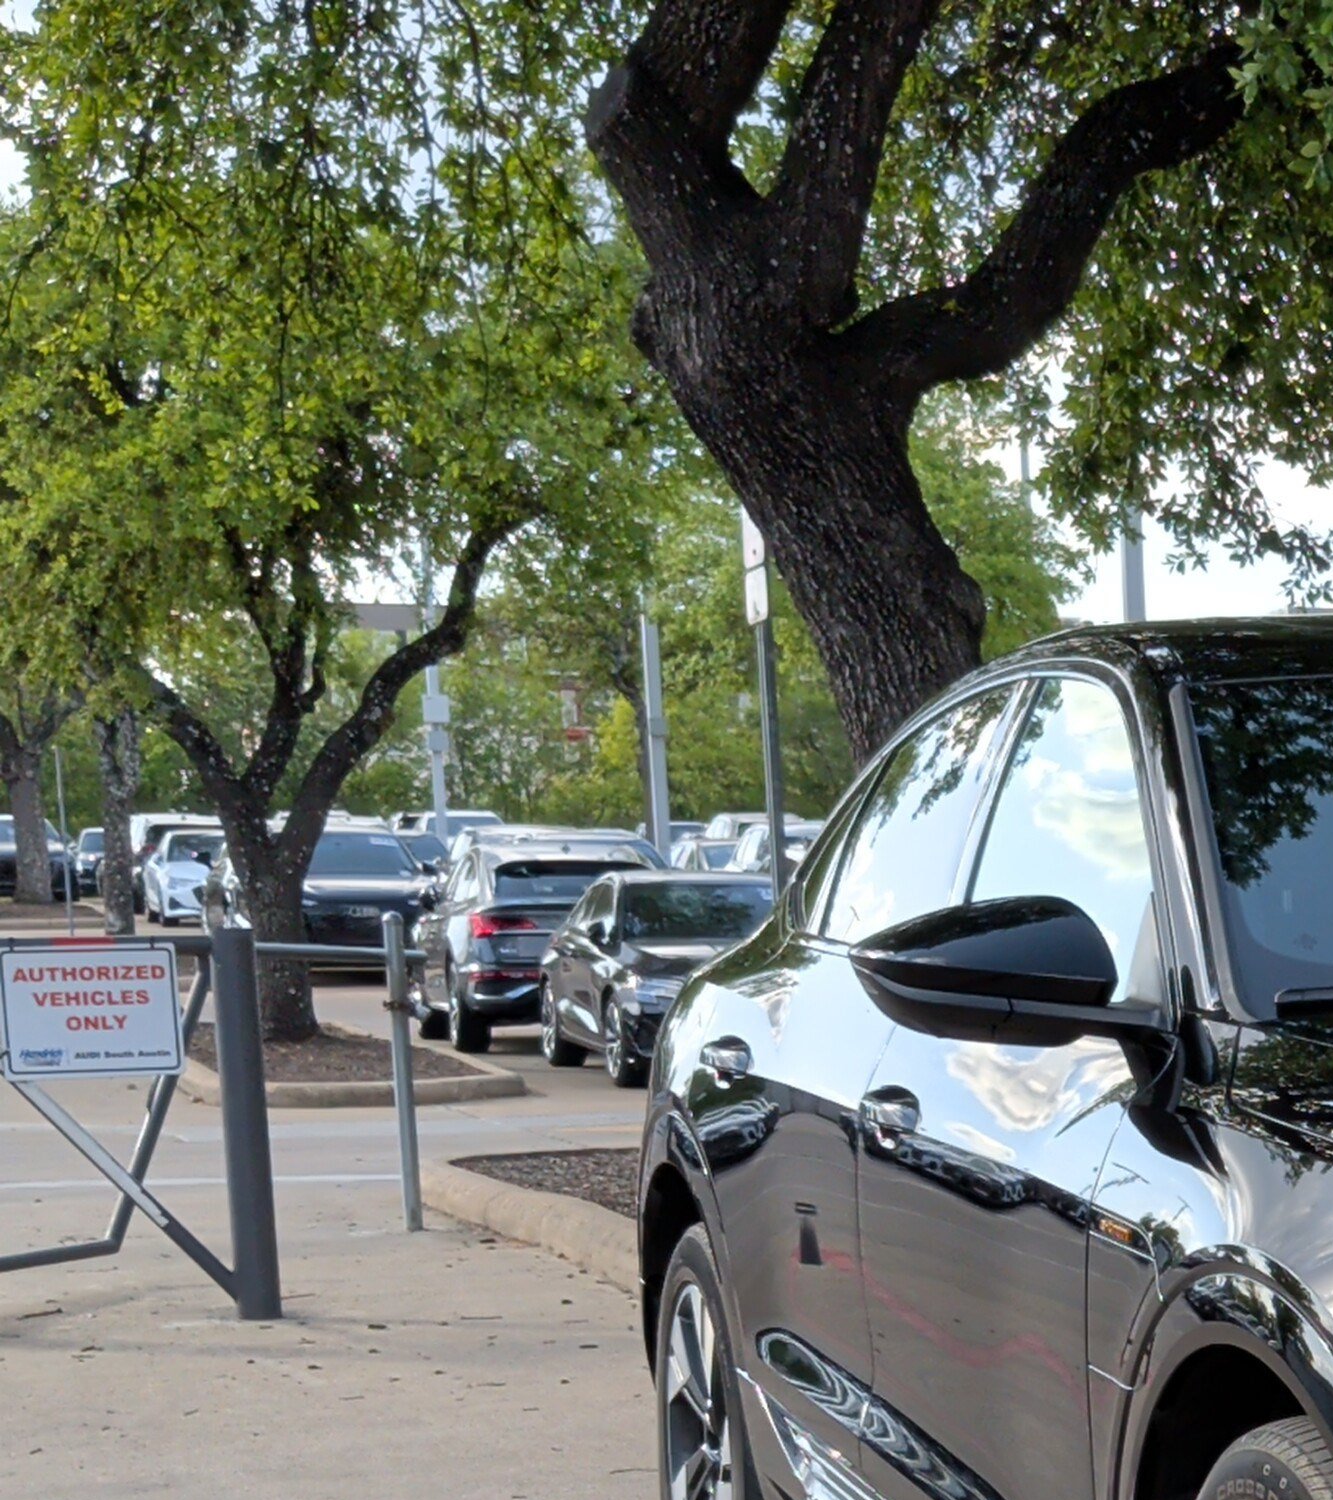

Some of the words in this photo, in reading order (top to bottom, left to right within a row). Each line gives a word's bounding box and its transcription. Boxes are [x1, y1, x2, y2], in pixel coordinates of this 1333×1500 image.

[13, 966, 165, 982] AUTHORIZED
[33, 991, 149, 1006] VEHICLES
[66, 1015, 127, 1031] ONLY
